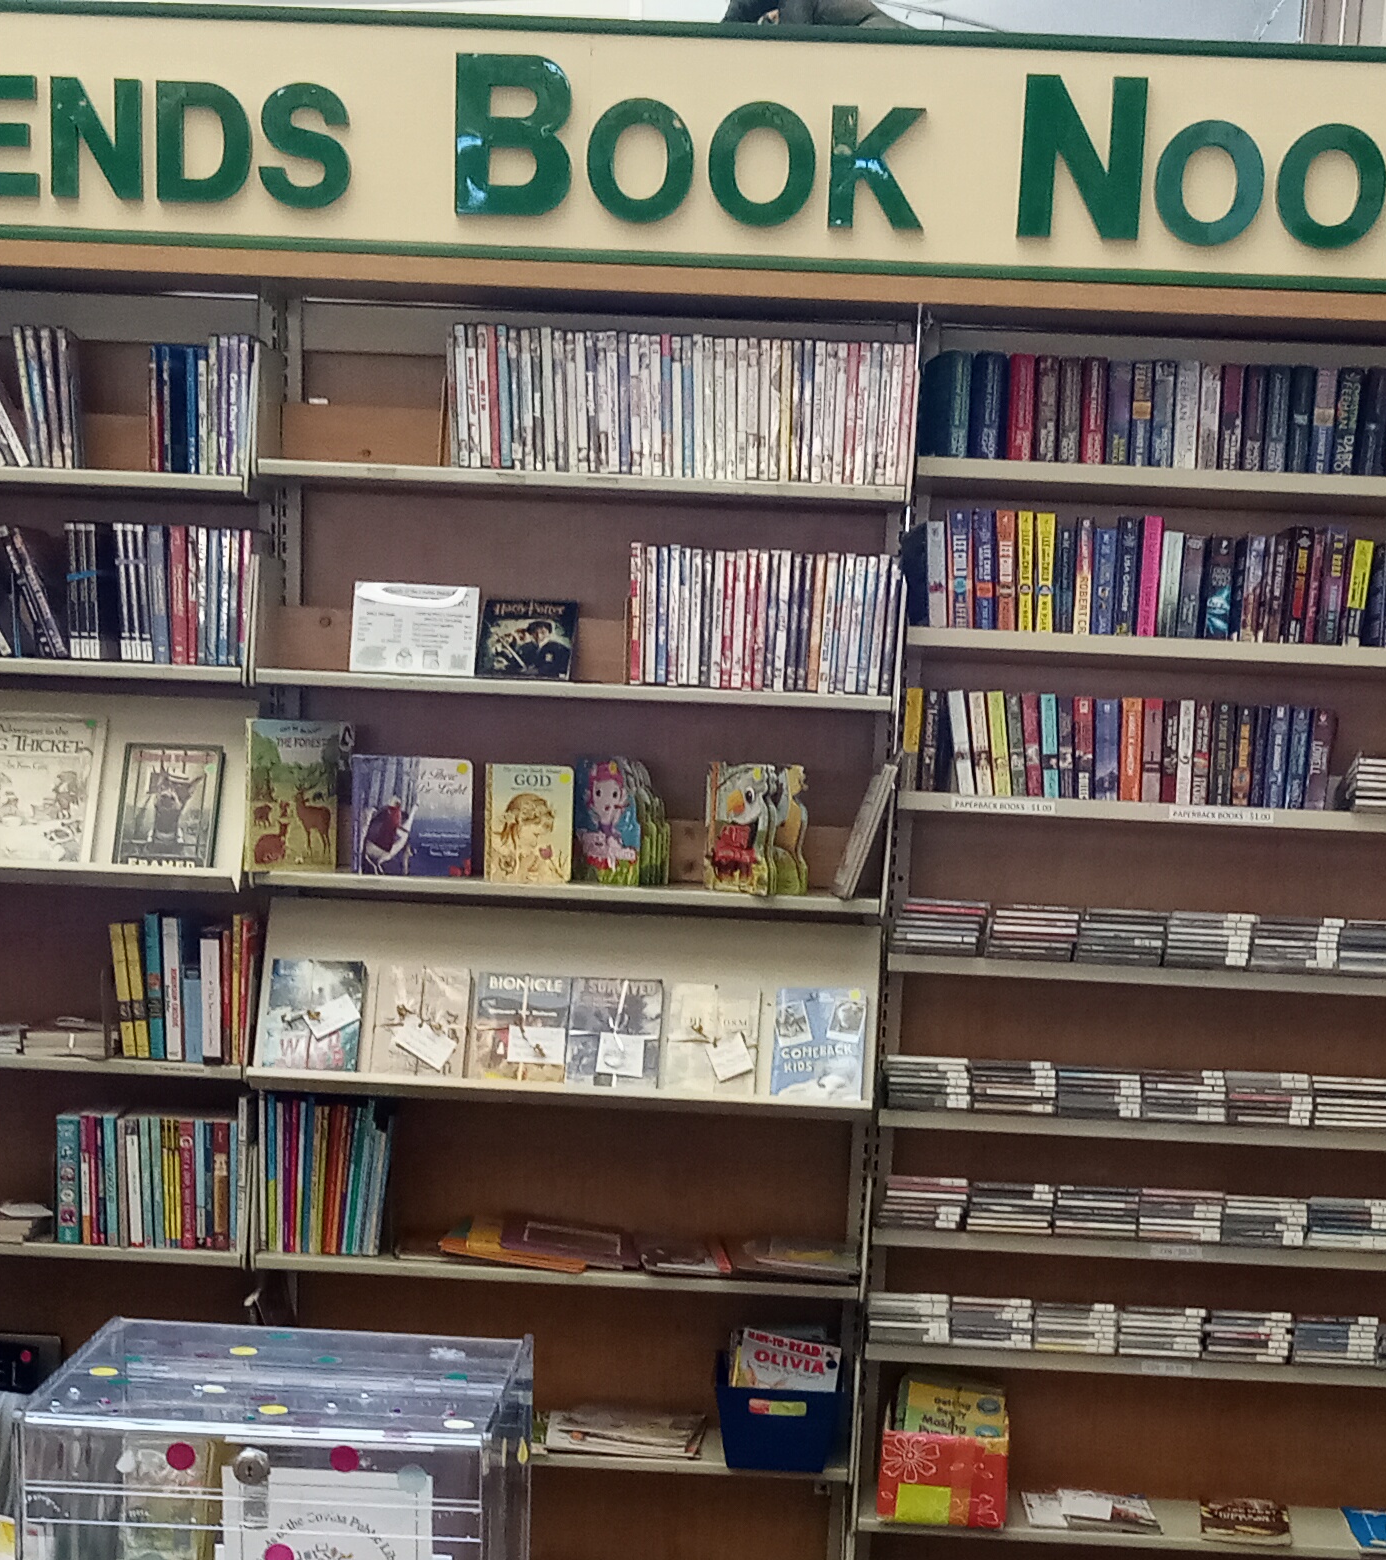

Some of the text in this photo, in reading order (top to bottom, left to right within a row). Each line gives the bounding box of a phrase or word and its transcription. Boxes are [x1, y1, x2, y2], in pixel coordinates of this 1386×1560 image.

[455, 52, 927, 230] BOOK
[13, 735, 91, 755] THICKET
[514, 773, 552, 788] GOD
[489, 976, 563, 993] BIONICLE
[783, 1061, 814, 1074] KIDS
[753, 1349, 825, 1376] OLIVIA
